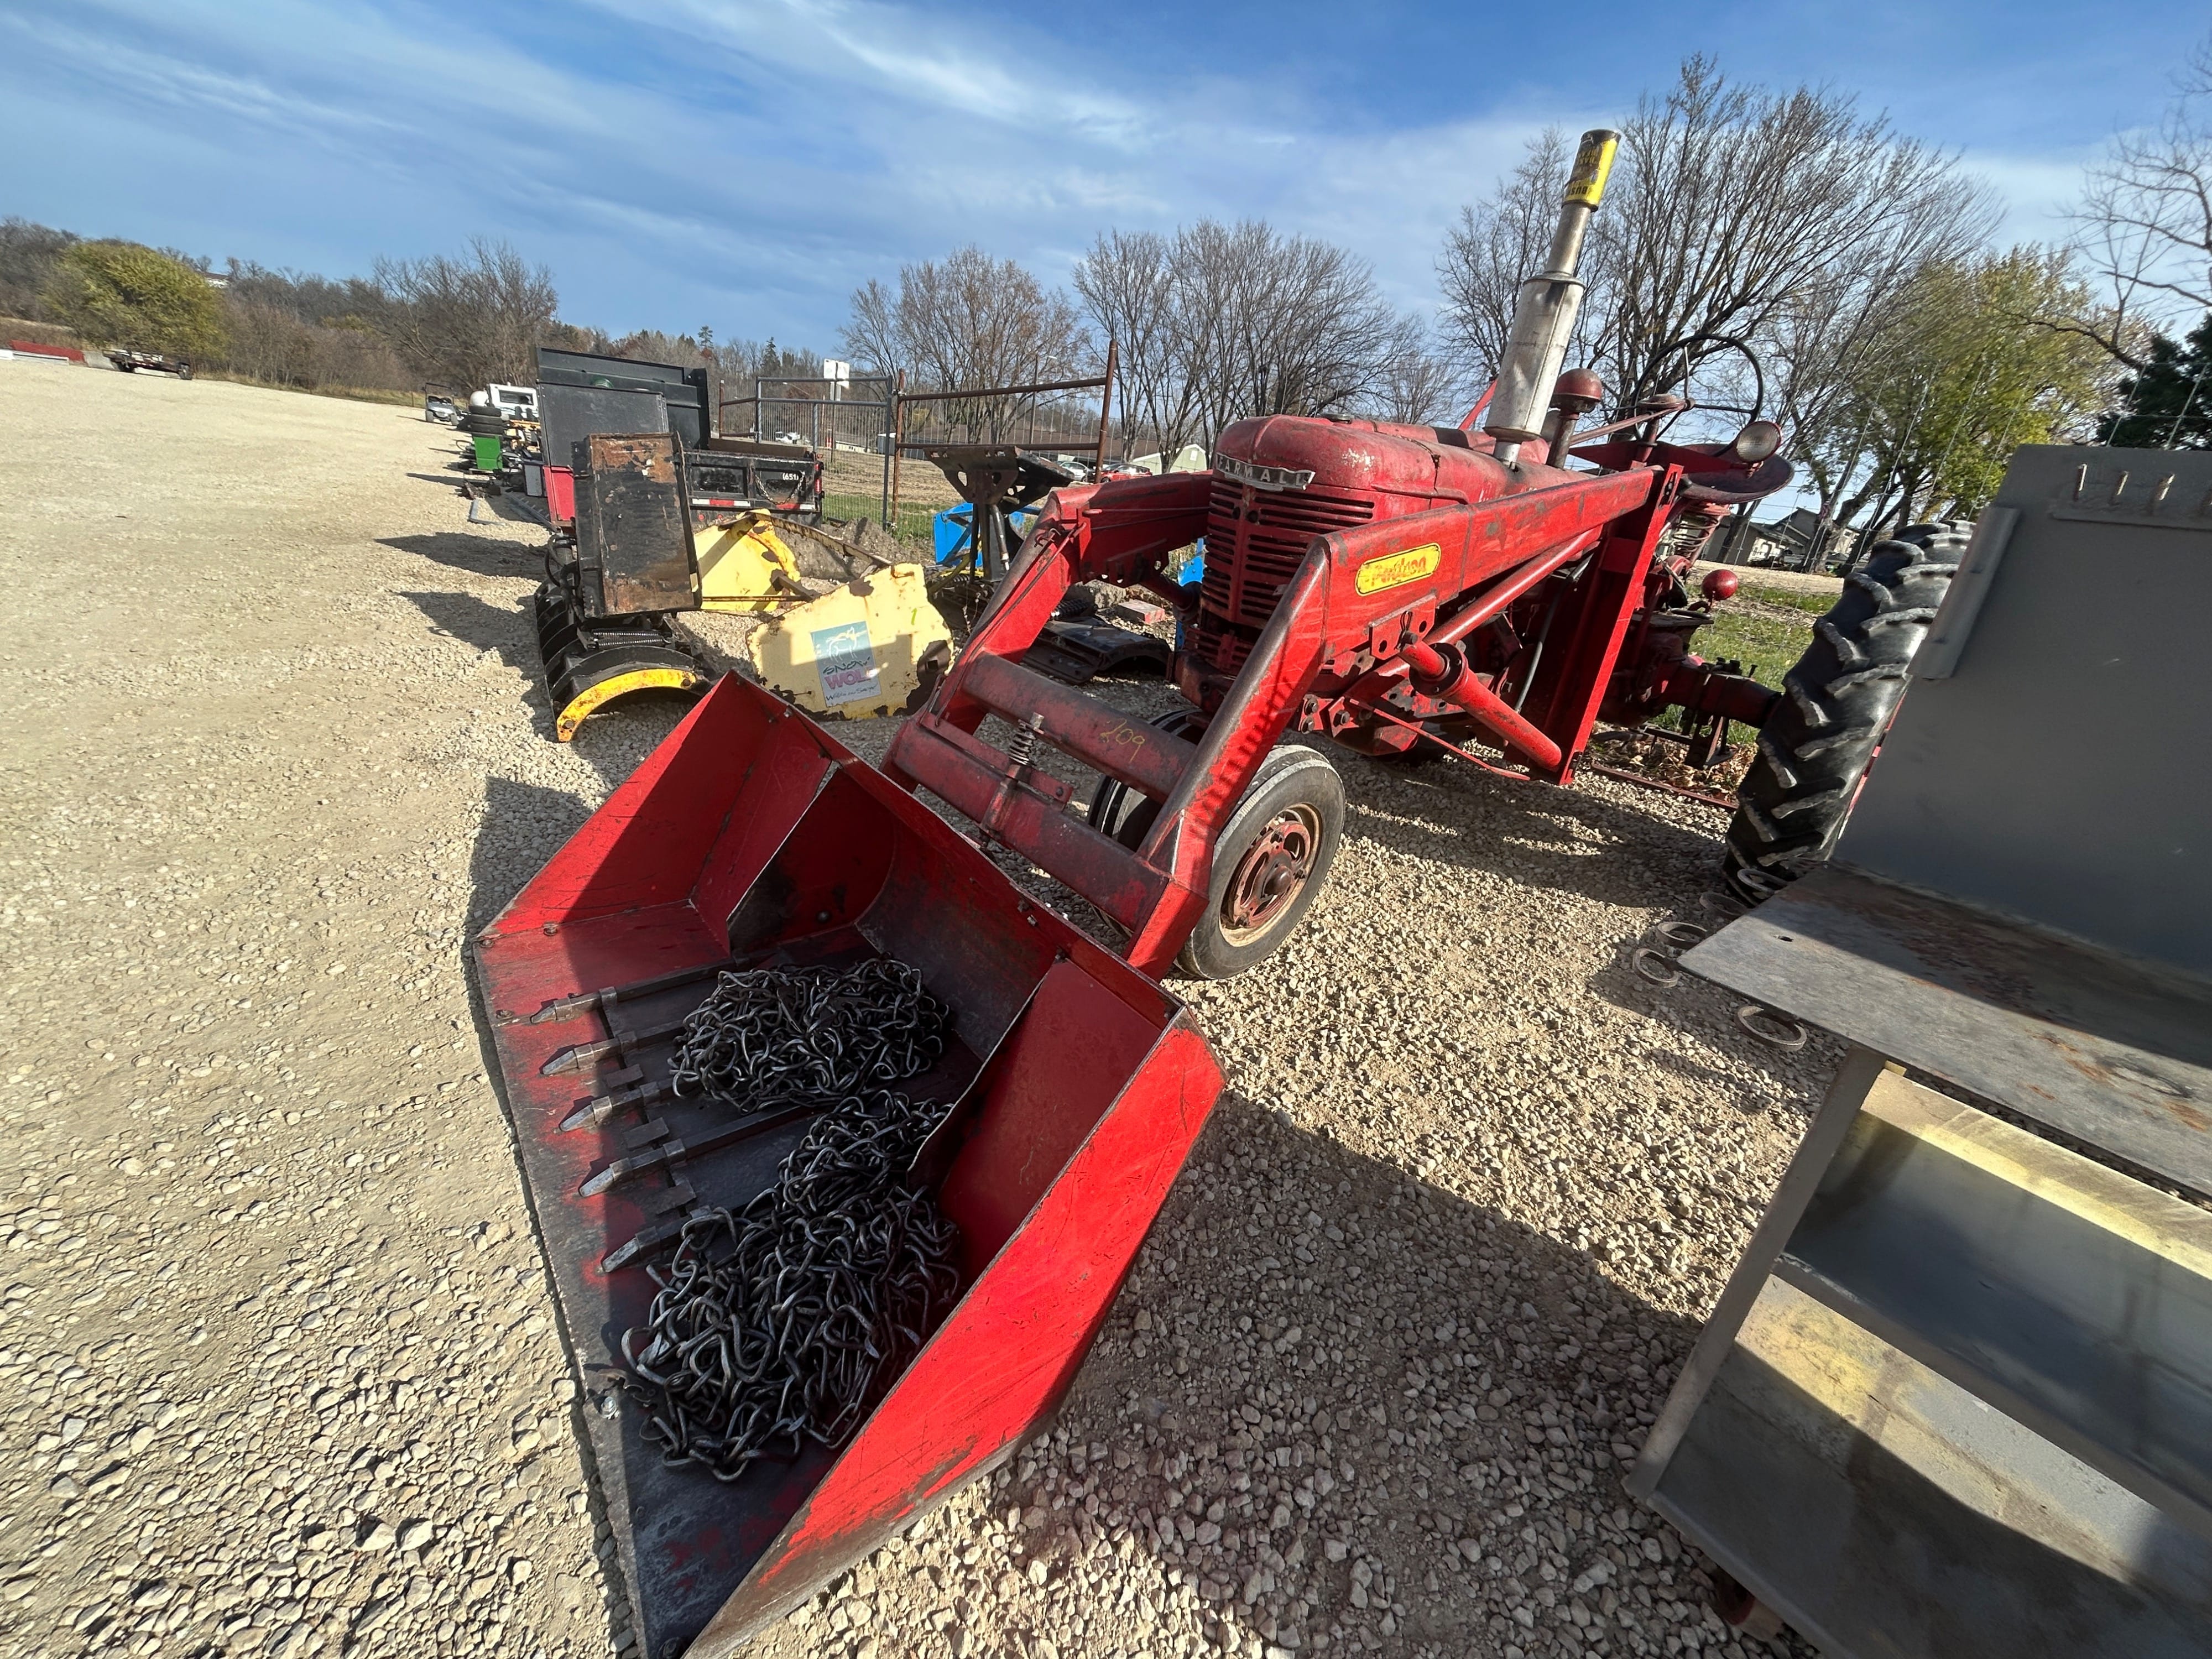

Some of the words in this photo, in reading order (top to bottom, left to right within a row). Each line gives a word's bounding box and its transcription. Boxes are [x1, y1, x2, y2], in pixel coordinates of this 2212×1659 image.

[782, 472, 799, 481] (651)
[1218, 456, 1305, 486] FARMALL
[823, 656, 870, 675] SNOW
[824, 666, 876, 690] WOL
[1100, 717, 1145, 764] 209
